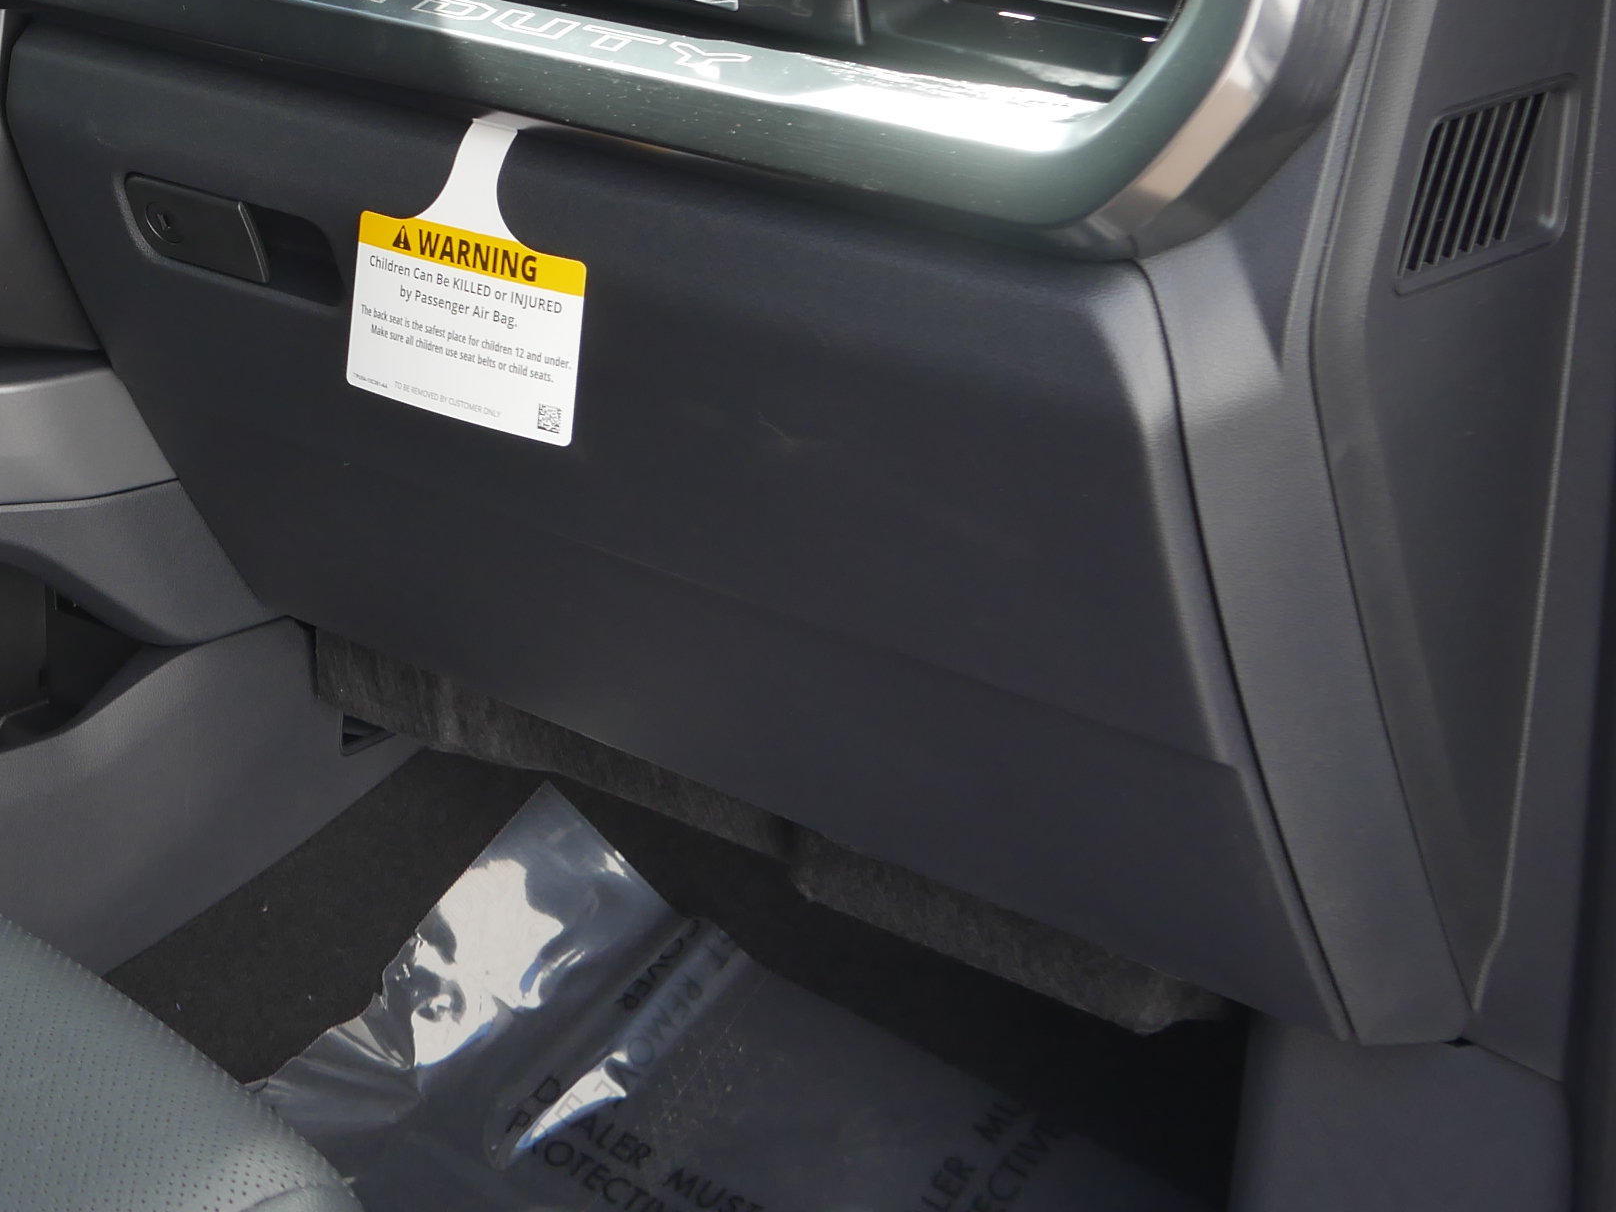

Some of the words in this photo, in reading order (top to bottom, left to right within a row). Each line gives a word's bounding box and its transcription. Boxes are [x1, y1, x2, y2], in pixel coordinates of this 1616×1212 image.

[369, 255, 410, 277] Children
[413, 267, 433, 283] Can
[436, 273, 450, 287] Be
[452, 277, 492, 297] KILLED
[494, 290, 507, 301] or
[510, 292, 563, 314] INJURED
[418, 228, 538, 282] WARNING
[361, 304, 372, 316] The
[373, 308, 388, 321] back
[389, 314, 403, 326] seat
[404, 317, 411, 328] is
[412, 319, 423, 332] the
[424, 325, 446, 339] safest
[447, 330, 466, 344] place
[468, 334, 479, 346] for
[481, 339, 512, 355] children
[515, 348, 524, 358] 12
[526, 350, 542, 362] and
[544, 355, 572, 370] under.
[399, 285, 412, 302] by
[415, 290, 470, 315] Passenger
[472, 305, 489, 320] Air
[492, 311, 518, 330] Bag.
[370, 324, 388, 338] Make
[389, 331, 404, 343] sure
[405, 335, 414, 346] all
[415, 337, 444, 355] children
[445, 348, 458, 358] use
[459, 351, 475, 363] seat
[477, 354, 496, 368] belts
[498, 361, 507, 371] or
[508, 363, 528, 377] child
[530, 368, 554, 383] seats.
[394, 380, 402, 390] TO
[403, 383, 410, 393] BE
[411, 385, 439, 401] REMOVED
[440, 394, 448, 403] BY
[448, 397, 482, 414] CUSTOMER
[483, 407, 501, 418] ONLY
[614, 919, 702, 1010] COVER
[533, 1075, 652, 1169] DEALER
